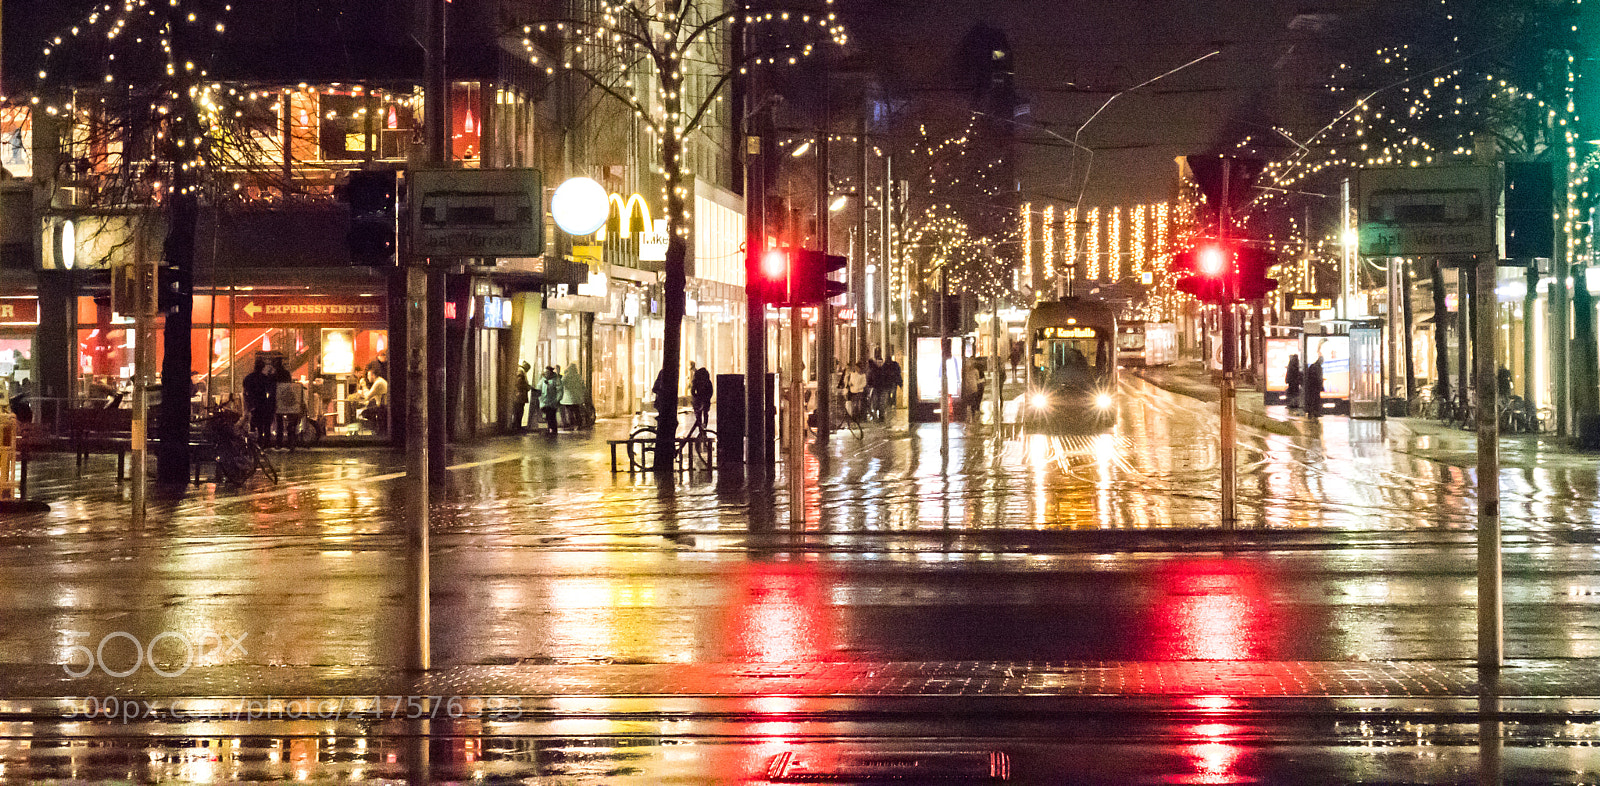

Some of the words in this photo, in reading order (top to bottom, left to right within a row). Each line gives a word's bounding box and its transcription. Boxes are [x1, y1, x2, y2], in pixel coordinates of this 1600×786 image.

[465, 234, 522, 250] Vorrang
[1416, 233, 1474, 249] Vorrang
[265, 304, 380, 314] EXPRESSFENSTER
